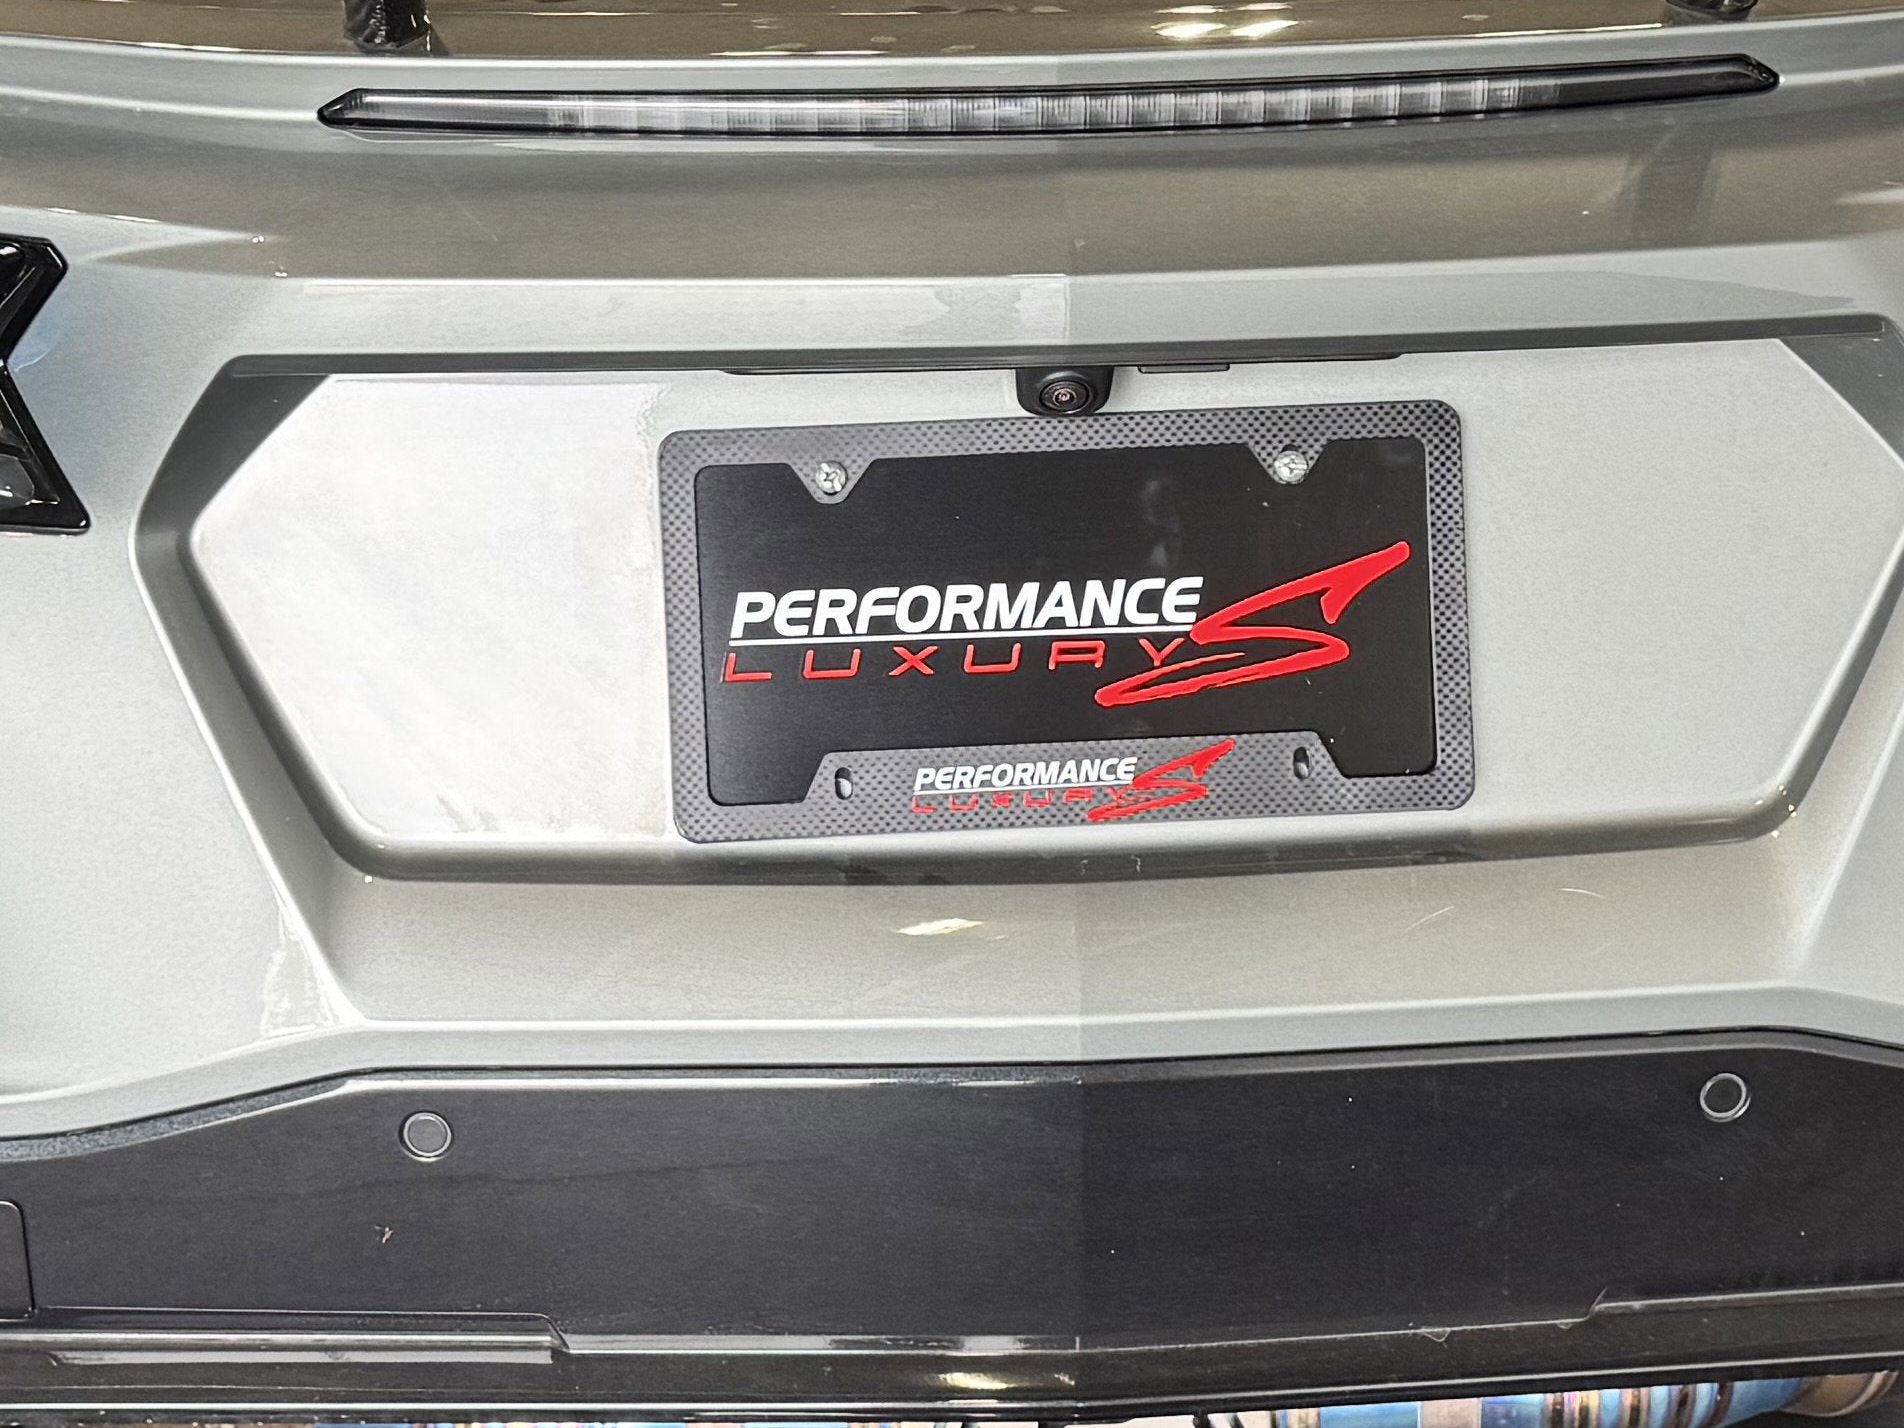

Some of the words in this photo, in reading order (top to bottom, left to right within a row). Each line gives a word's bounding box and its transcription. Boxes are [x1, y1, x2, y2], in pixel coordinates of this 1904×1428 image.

[730, 576, 1204, 639] PERFORMANCE
[721, 638, 1186, 684] LUXURY
[914, 756, 1139, 791] PERFORMANCE
[912, 785, 1132, 814] LUXURY
